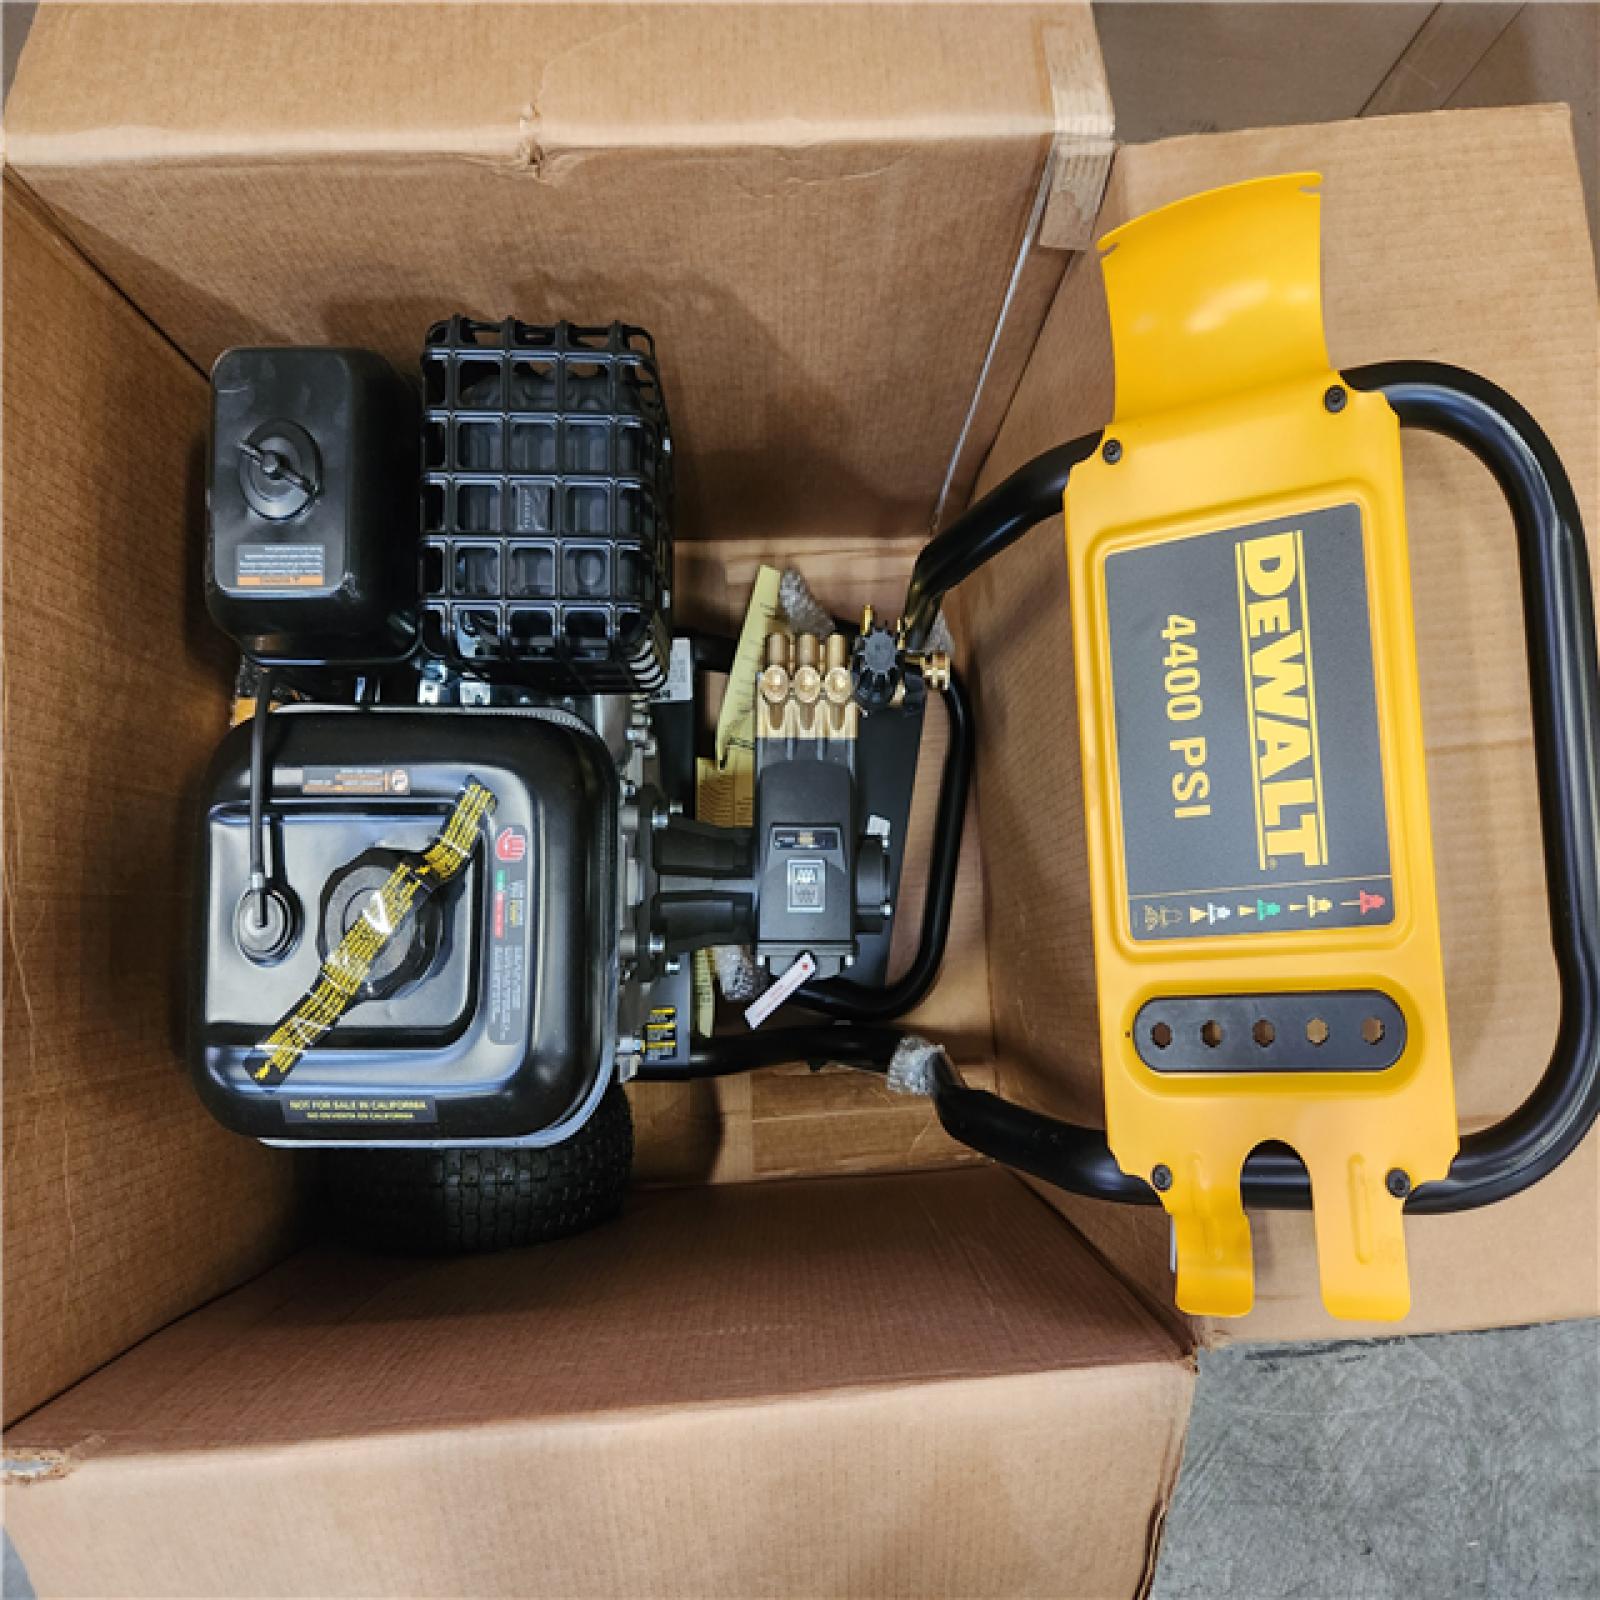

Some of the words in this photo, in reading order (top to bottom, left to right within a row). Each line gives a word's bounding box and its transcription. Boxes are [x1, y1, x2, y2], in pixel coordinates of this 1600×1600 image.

[1160, 615, 1203, 721] 4400
[1243, 531, 1322, 868] DEWALT
[1169, 736, 1212, 819] PSI
[289, 1100, 311, 1110] NOT
[312, 1100, 331, 1110] FOR
[333, 1100, 356, 1110] SALE
[371, 1100, 427, 1110] CALIFORNIA
